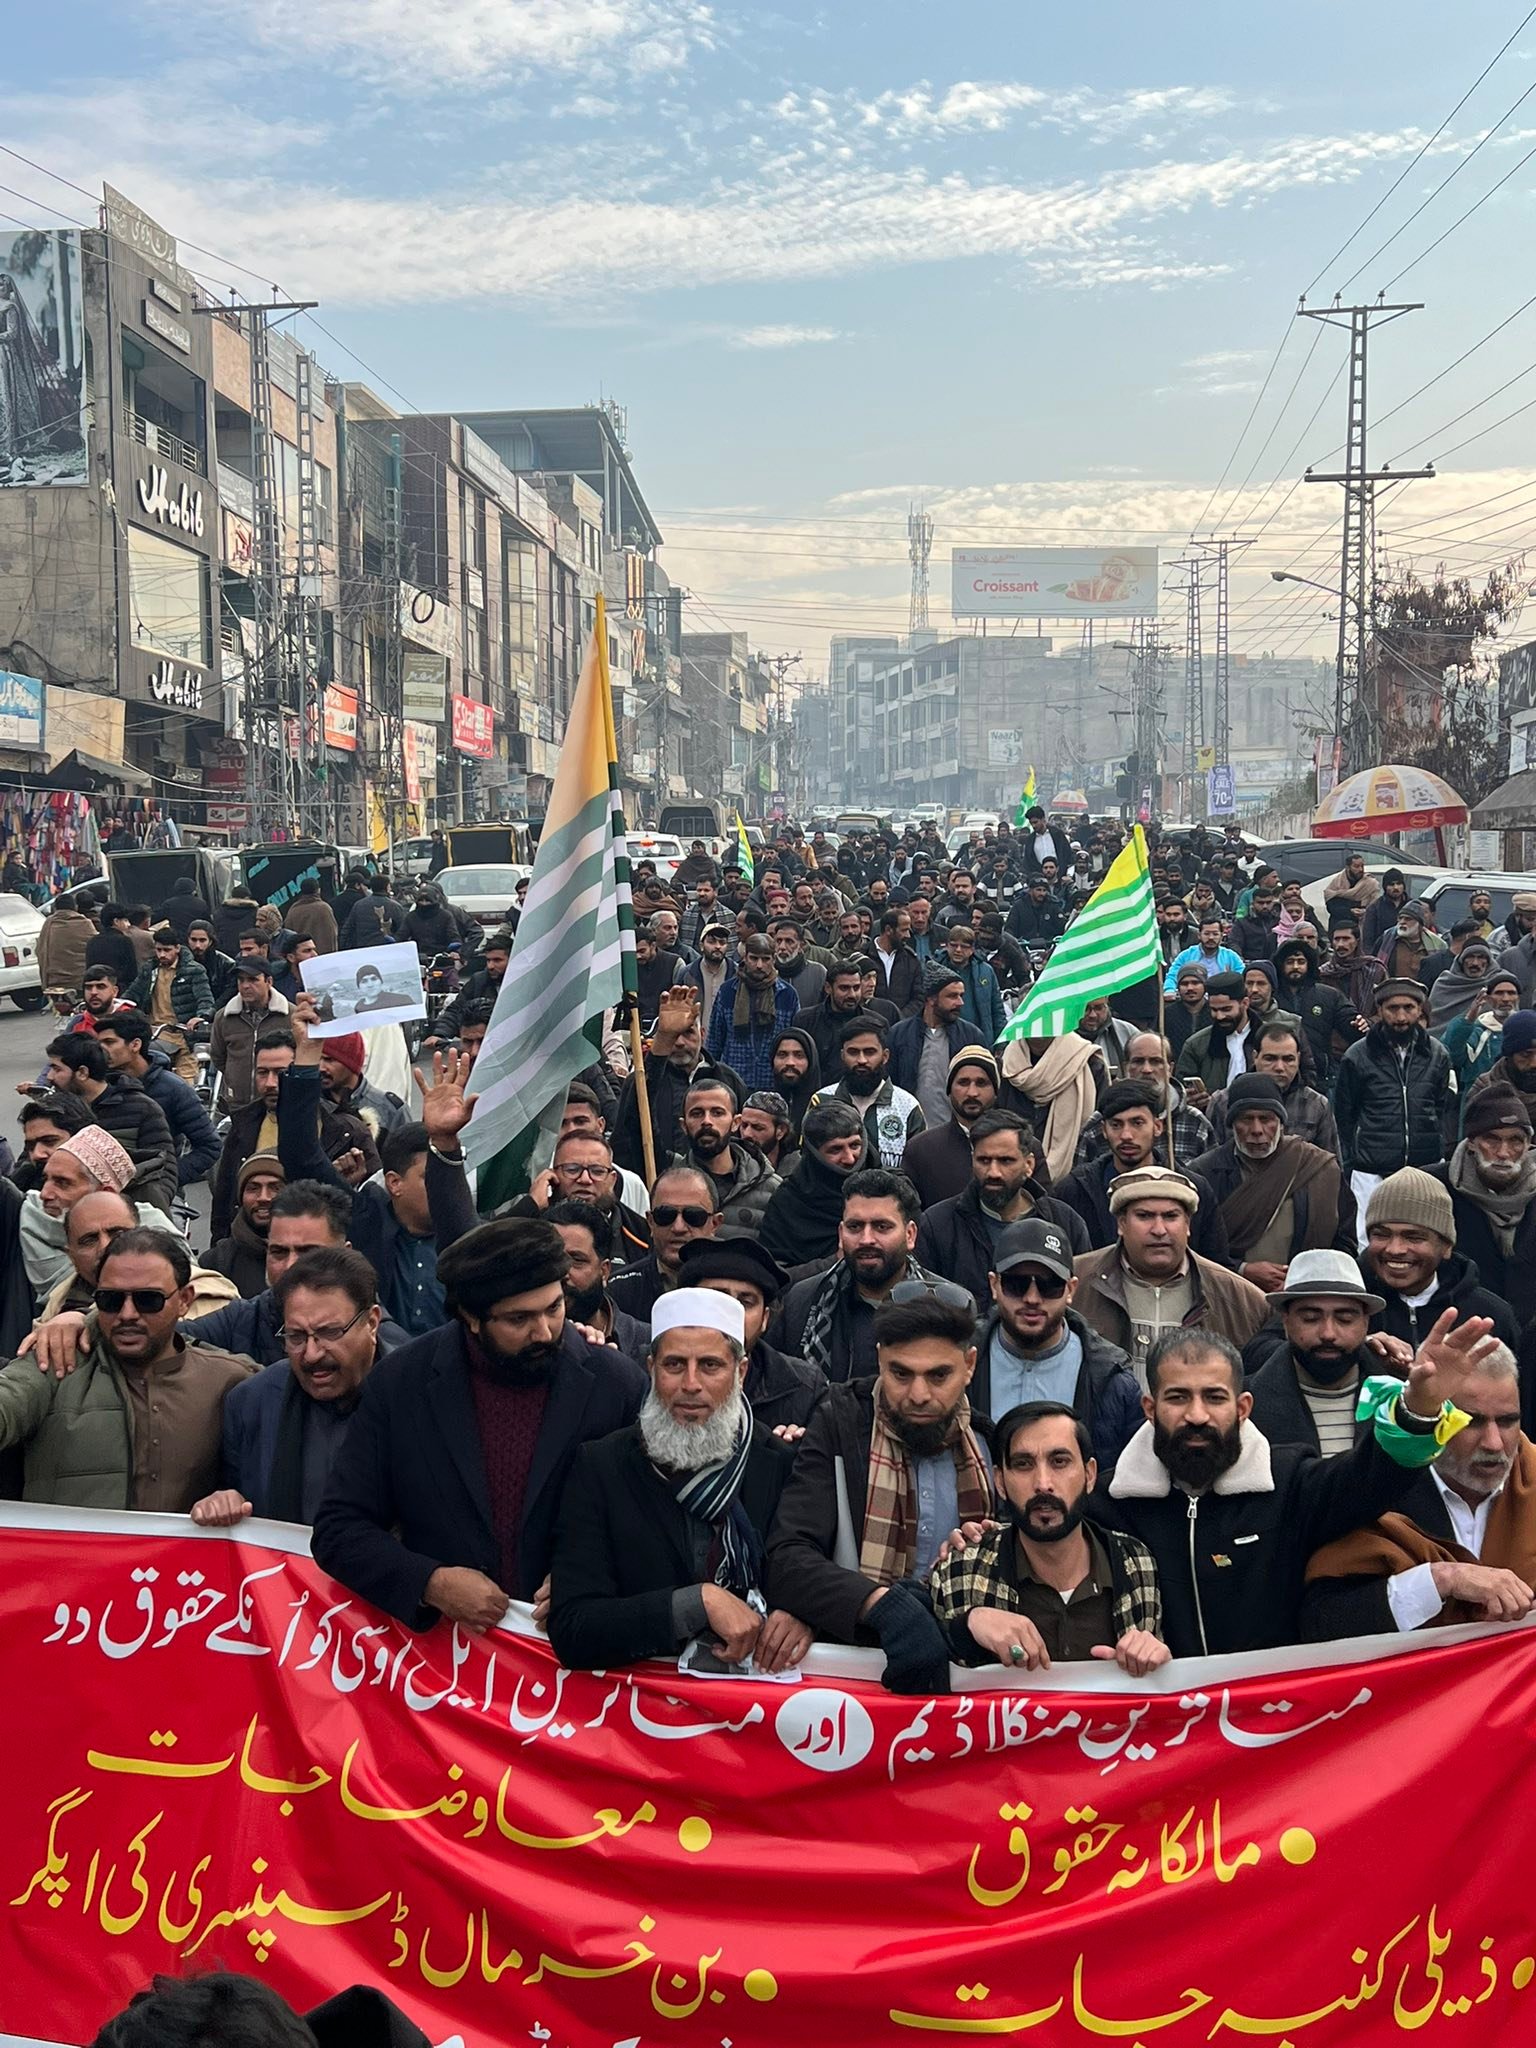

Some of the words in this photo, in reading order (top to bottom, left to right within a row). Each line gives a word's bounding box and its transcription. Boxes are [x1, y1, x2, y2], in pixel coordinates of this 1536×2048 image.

[973, 580, 1039, 593] Croissant
[1215, 780, 1230, 788] SALE
[42, 1602, 92, 1645] دو
[98, 1566, 227, 1659] حقوق
[295, 1599, 353, 1671] کو
[798, 1697, 848, 1758] اور
[889, 1695, 974, 1782] ڈیم
[99, 1810, 164, 1936] کی
[967, 1802, 1125, 1907] حقوق
[1106, 1798, 1262, 1894] مالکانہ
[157, 1854, 410, 1968] ڈسپنسری
[650, 1947, 726, 2020] بن
[1393, 1903, 1498, 2030] ذیلی
